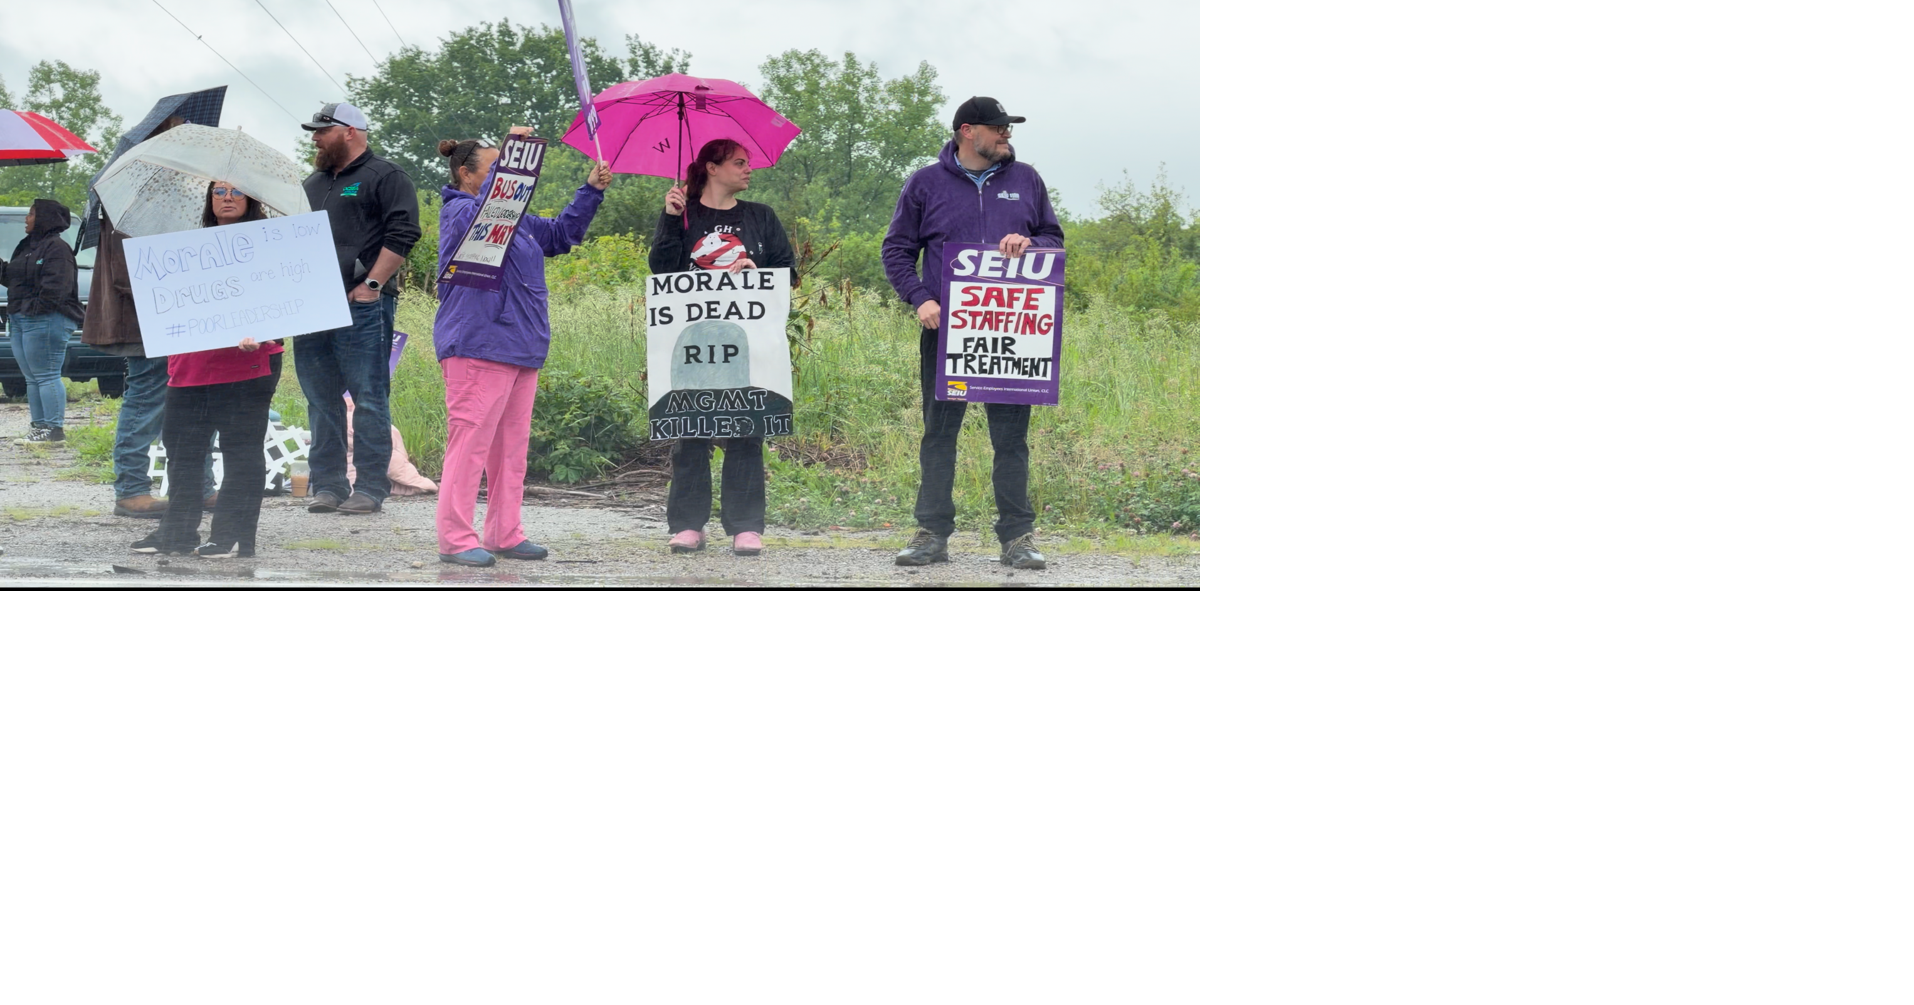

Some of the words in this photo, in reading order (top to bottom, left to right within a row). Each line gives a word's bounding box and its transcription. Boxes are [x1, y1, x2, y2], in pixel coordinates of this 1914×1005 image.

[499, 139, 543, 171] SEIU
[490, 177, 518, 200] BUS
[513, 182, 534, 203] OUT
[261, 226, 283, 242] is
[292, 223, 321, 239] low
[468, 222, 493, 242] THIS
[485, 224, 516, 245] MAY
[250, 267, 277, 282] are
[281, 258, 311, 283] high
[953, 249, 1056, 280] SEIU
[651, 271, 775, 296] MORALE
[961, 286, 1045, 310] SAFE
[165, 299, 305, 338] #POORLEADERSHIP
[649, 306, 674, 327] IS
[685, 301, 766, 322] DEAD
[951, 309, 1054, 335] STAFFING
[683, 344, 739, 365] RIP
[963, 336, 1016, 355] FAIR
[946, 352, 1053, 379] TREATMENT
[665, 389, 768, 414] MGMT
[947, 389, 967, 397] SEIU
[650, 416, 755, 441] KILLED
[763, 413, 791, 436] IT
